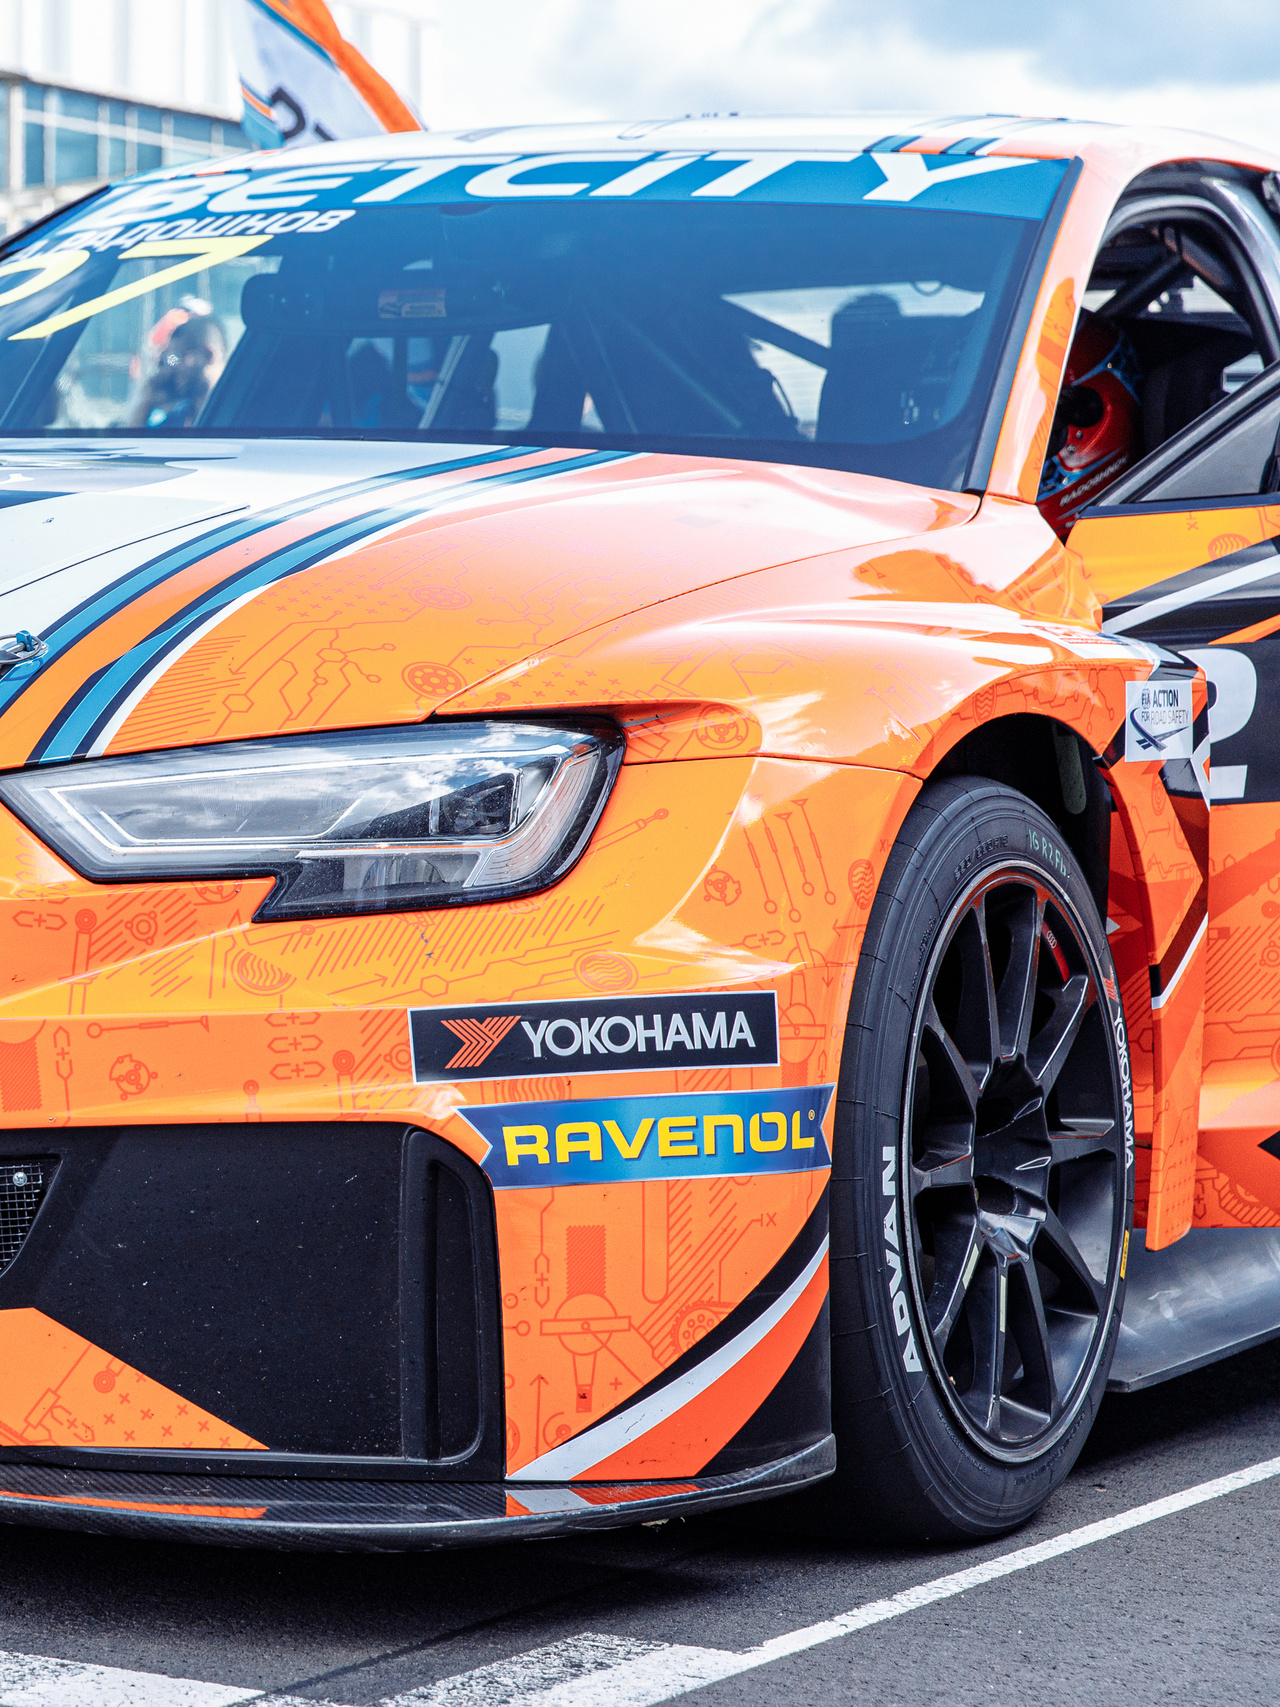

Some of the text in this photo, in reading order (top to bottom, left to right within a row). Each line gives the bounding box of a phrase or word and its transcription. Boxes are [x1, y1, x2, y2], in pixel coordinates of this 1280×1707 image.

[55, 150, 1039, 236] BETCITY
[1141, 709, 1190, 725] FOR ROAD SAFETY
[1152, 689, 1179, 707] ACTION
[521, 1010, 756, 1057] YOKOHAMA
[1113, 1006, 1135, 1171] YOKOHAMA
[882, 1145, 924, 1373] ADVAN
